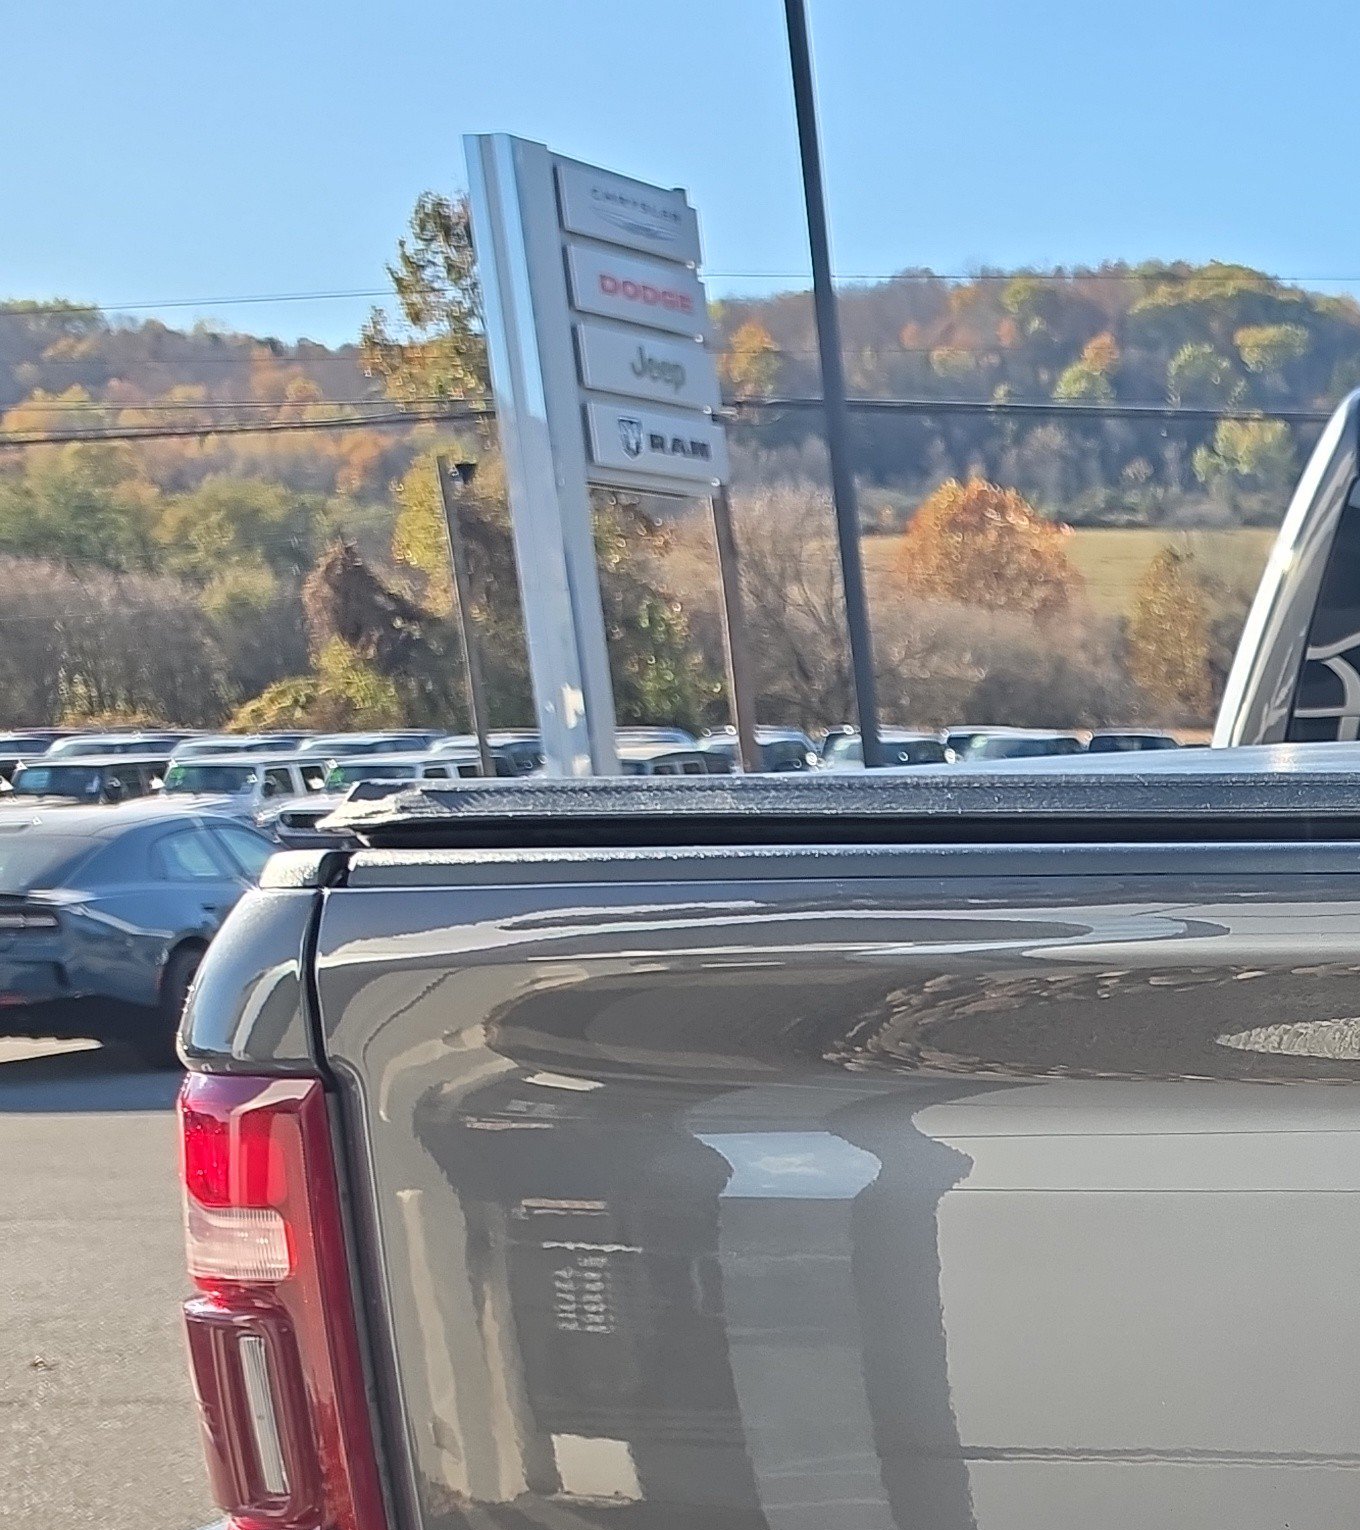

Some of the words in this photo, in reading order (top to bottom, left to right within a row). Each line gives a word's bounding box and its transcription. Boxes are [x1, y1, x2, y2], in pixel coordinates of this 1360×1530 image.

[599, 274, 694, 313] DODGE
[631, 346, 687, 395] Jeep
[648, 433, 711, 461] RAM
